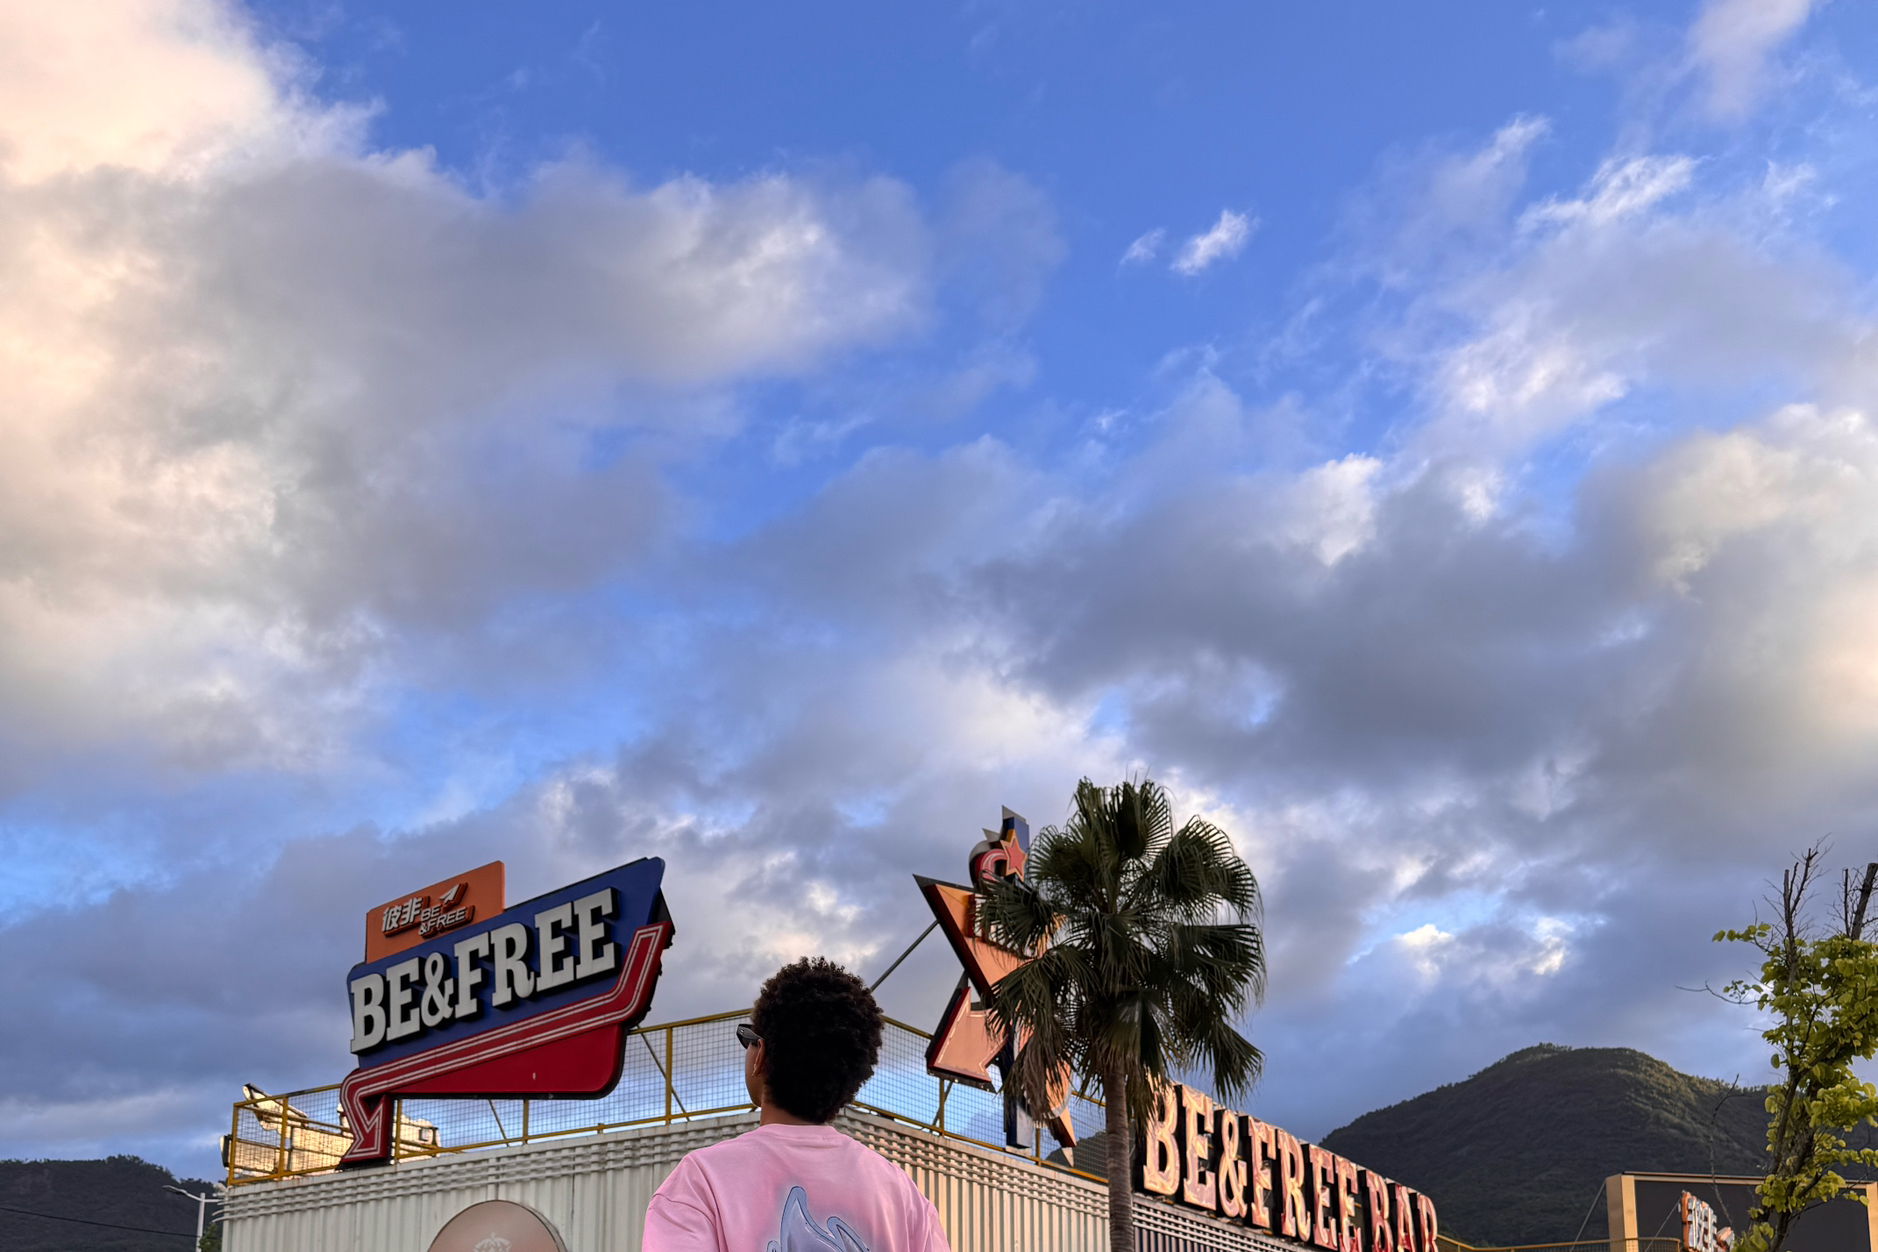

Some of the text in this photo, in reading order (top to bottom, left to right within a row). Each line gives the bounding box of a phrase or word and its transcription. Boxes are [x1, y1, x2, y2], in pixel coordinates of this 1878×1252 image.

[418, 906, 468, 935] &FREE
[421, 904, 443, 921] BE
[350, 887, 616, 1053] BE&FREE
